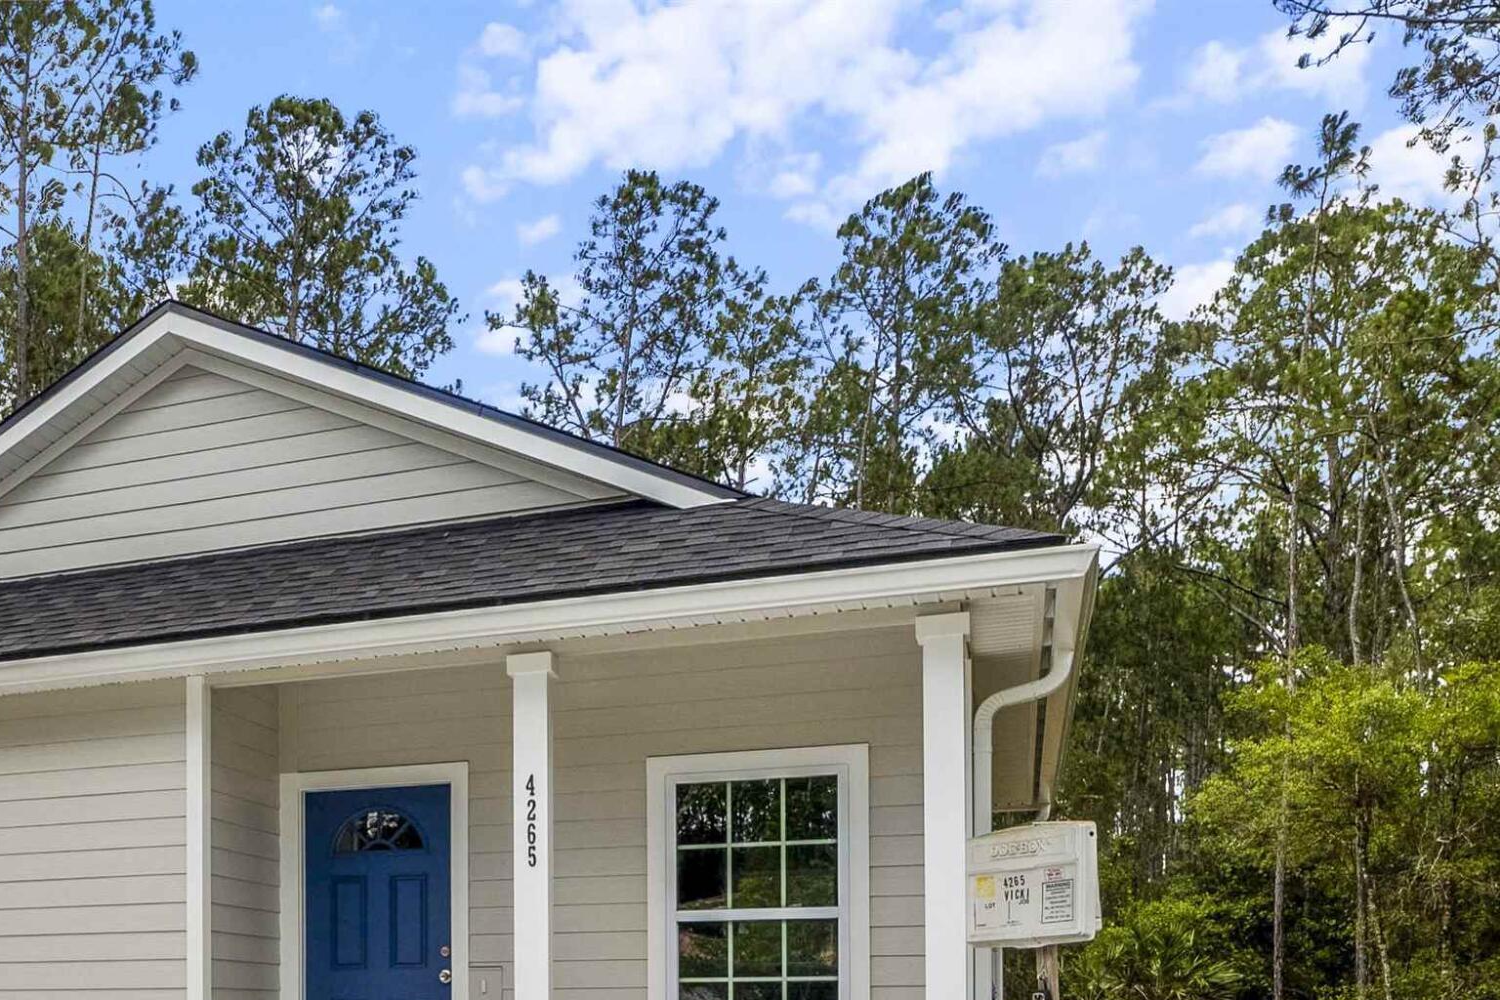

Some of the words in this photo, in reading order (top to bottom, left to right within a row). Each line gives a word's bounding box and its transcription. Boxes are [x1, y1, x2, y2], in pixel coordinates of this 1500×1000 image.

[526, 773, 537, 868] 4265
[1003, 874, 1026, 888] 4265
[1004, 888, 1030, 901] VICKI
